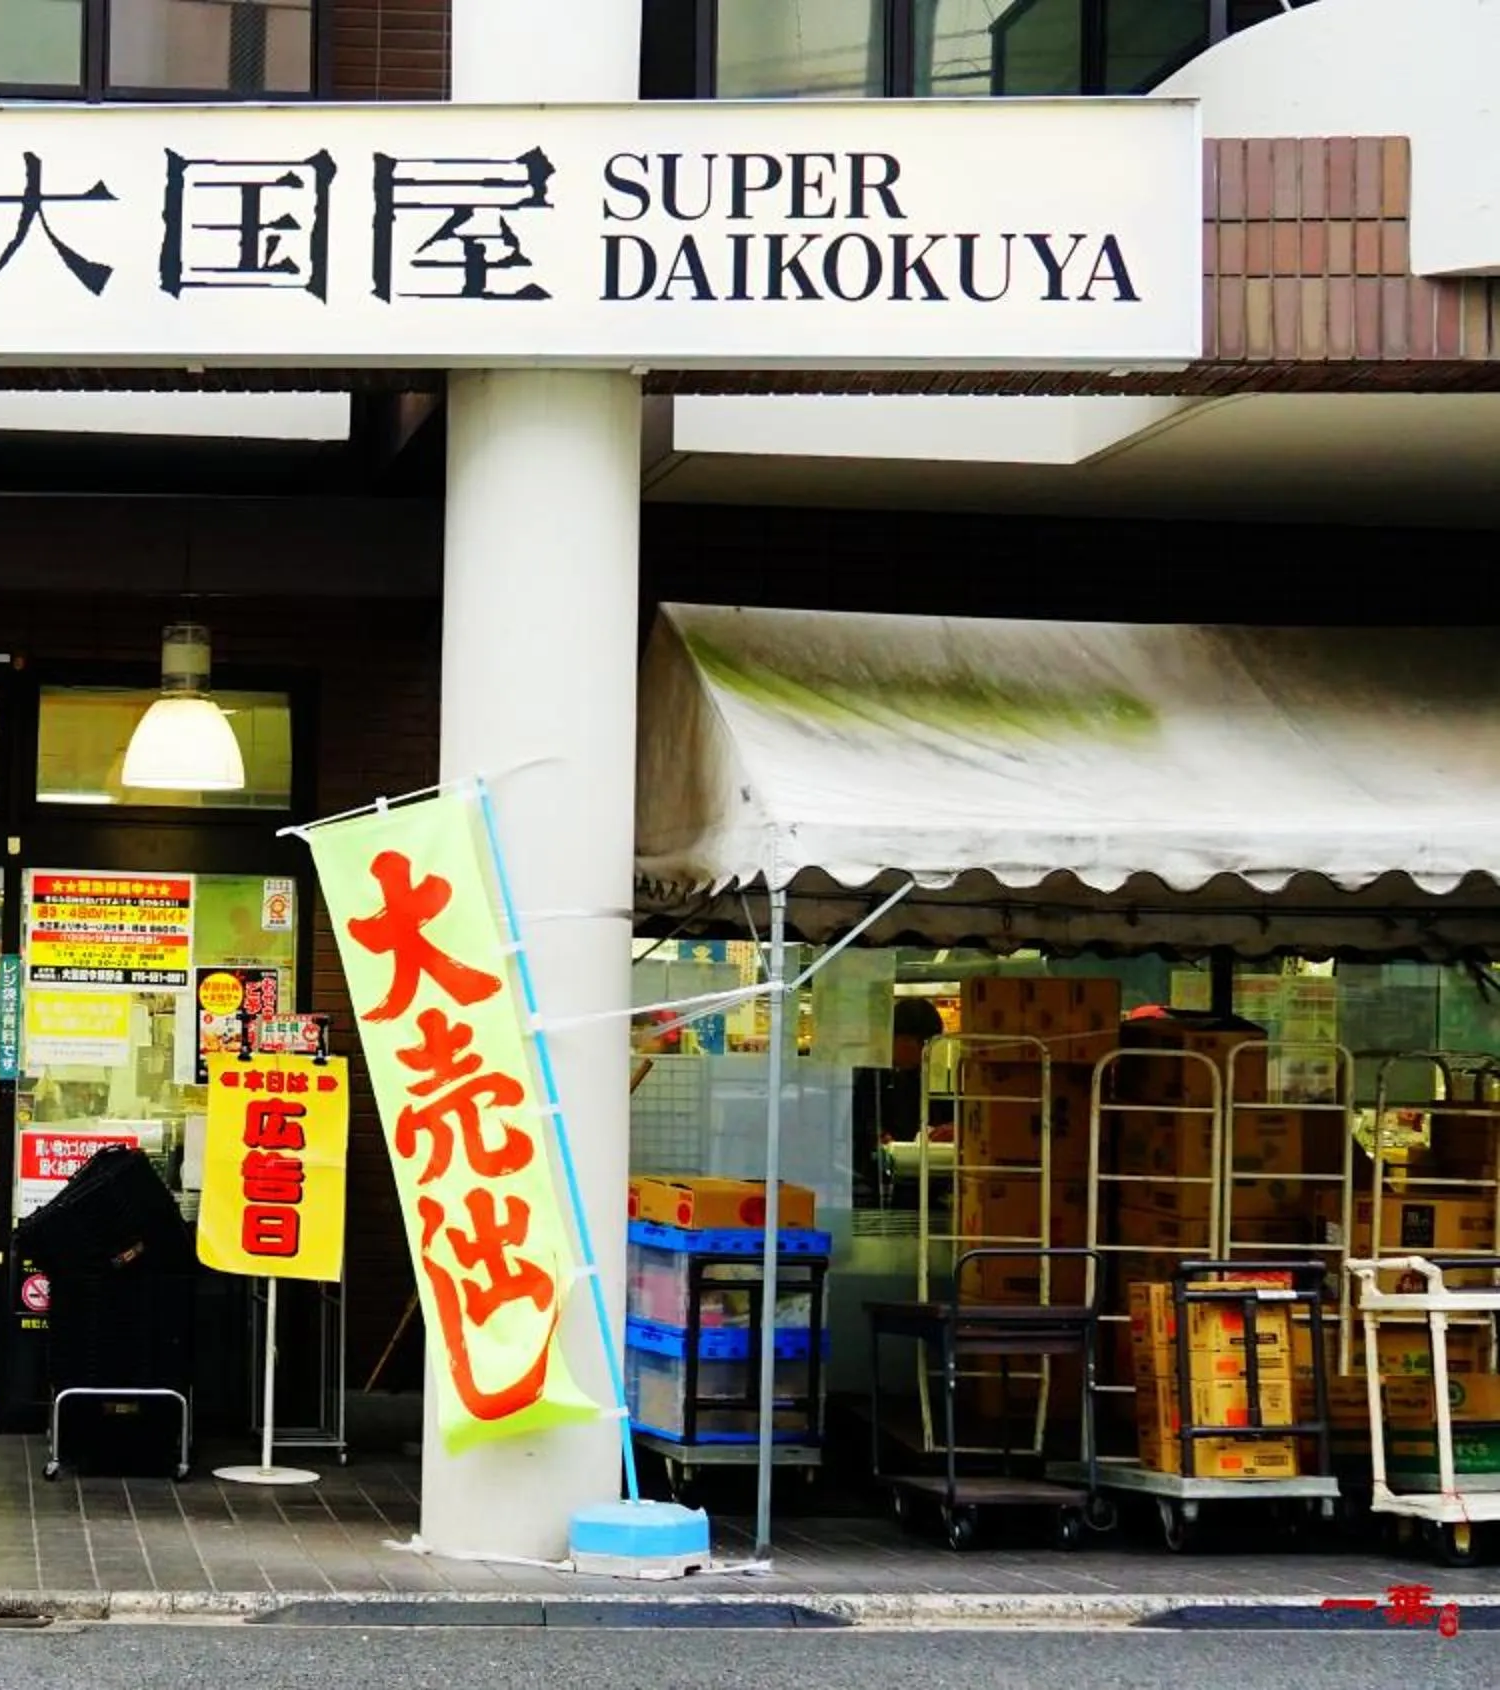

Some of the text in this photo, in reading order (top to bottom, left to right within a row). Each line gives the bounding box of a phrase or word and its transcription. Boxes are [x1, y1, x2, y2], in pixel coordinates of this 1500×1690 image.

[604, 154, 906, 220] SUPER
[601, 234, 1140, 301] DAIKOKUYA
[244, 1070, 309, 1093] 本日は
[347, 850, 555, 1421] 大売出し
[242, 1097, 307, 1258] 広告日
